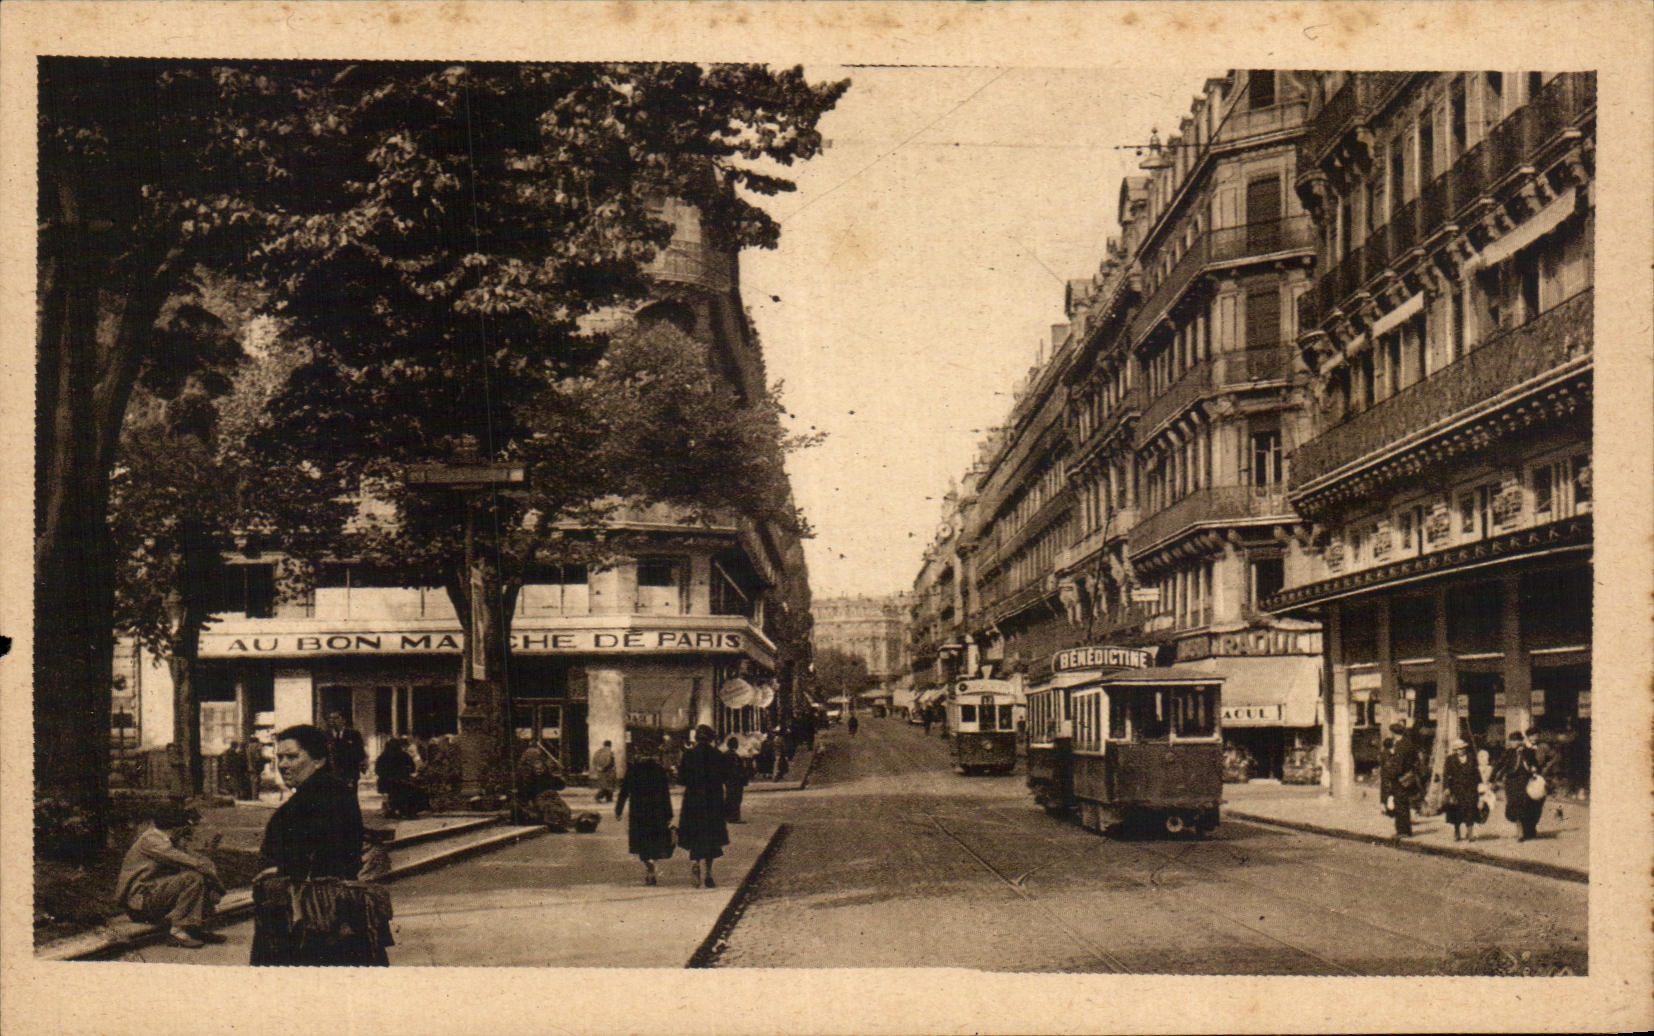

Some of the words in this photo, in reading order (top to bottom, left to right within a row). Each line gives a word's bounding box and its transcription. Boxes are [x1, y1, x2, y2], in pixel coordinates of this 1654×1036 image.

[228, 637, 279, 652] AU
[297, 635, 381, 651] BON
[401, 634, 577, 650] MAHE
[658, 632, 741, 648] PARIS
[1222, 630, 1304, 655] RAOUL
[1223, 708, 1267, 720] AOUL
